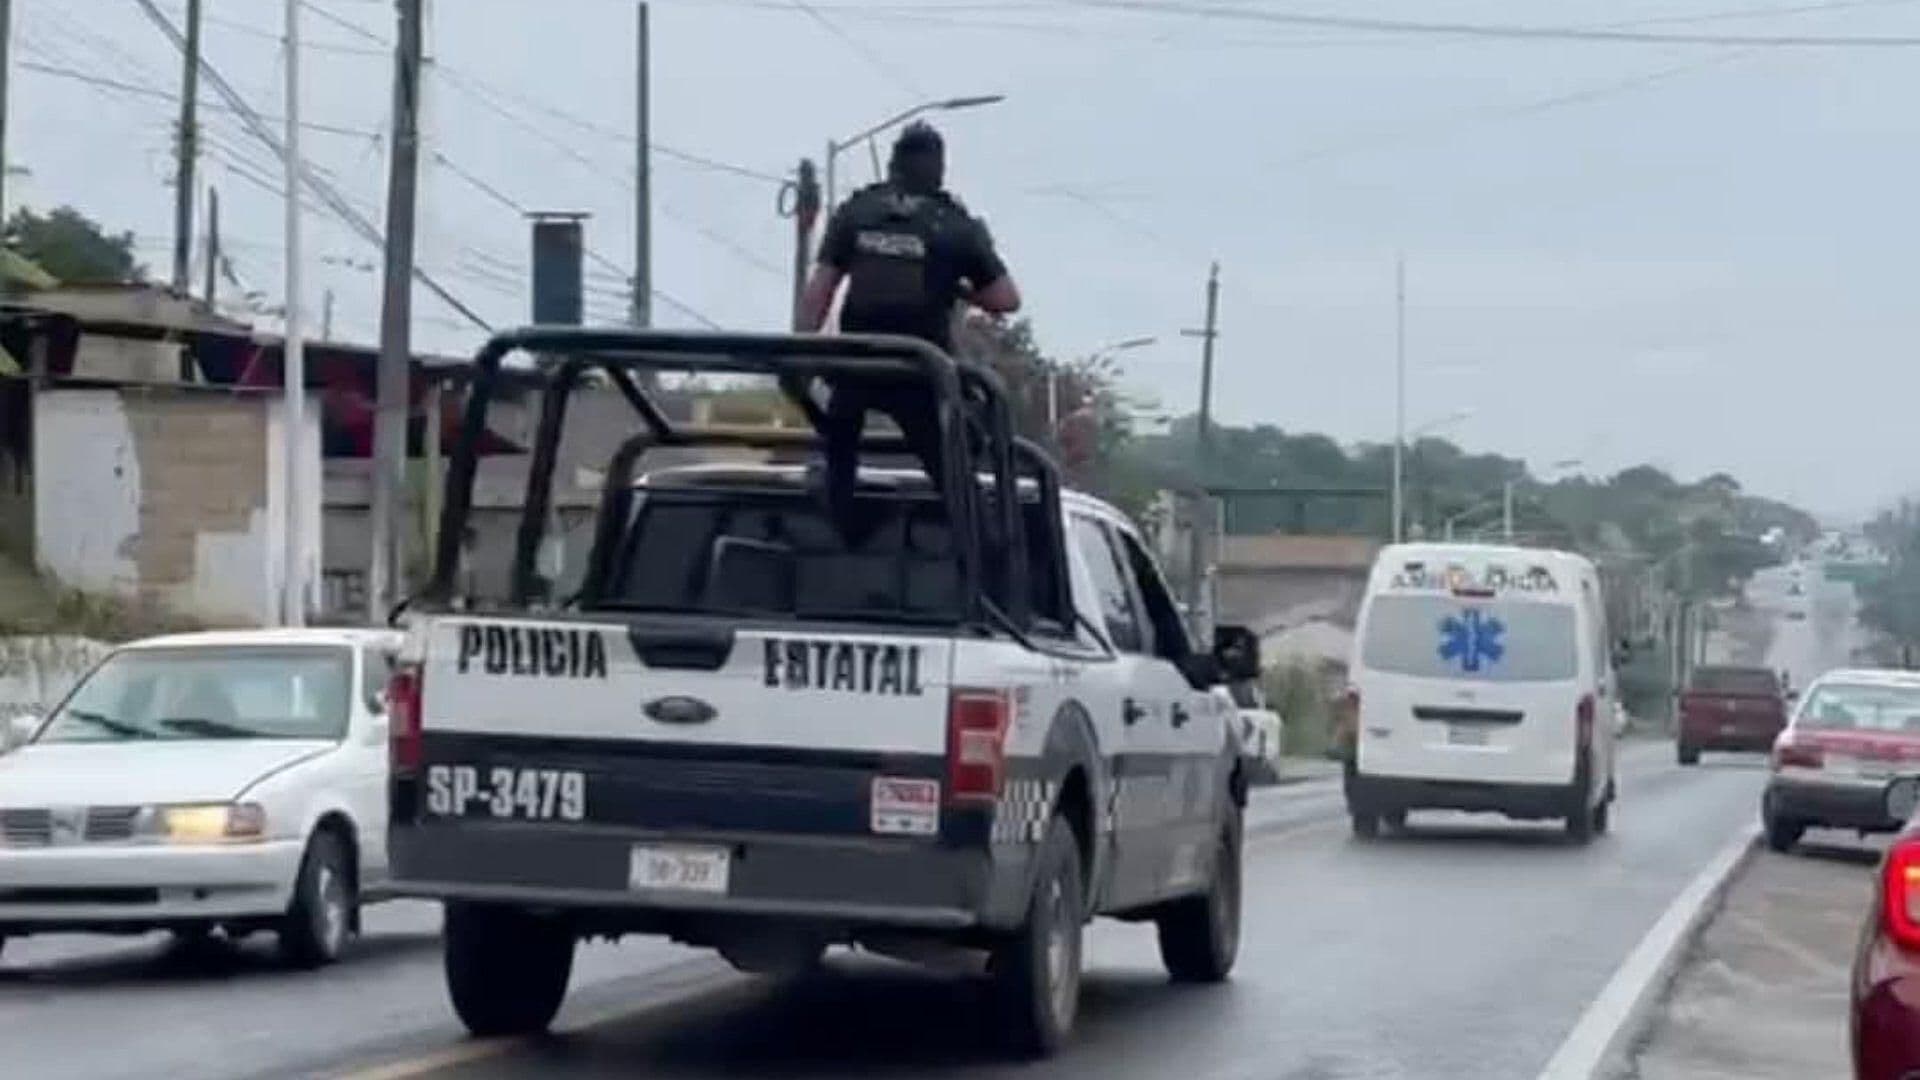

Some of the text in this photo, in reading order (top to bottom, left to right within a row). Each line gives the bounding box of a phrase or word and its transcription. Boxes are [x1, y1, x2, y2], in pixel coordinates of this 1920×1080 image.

[458, 625, 924, 696] POLICIA ESTATAL
[427, 764, 586, 820] SP-3479
